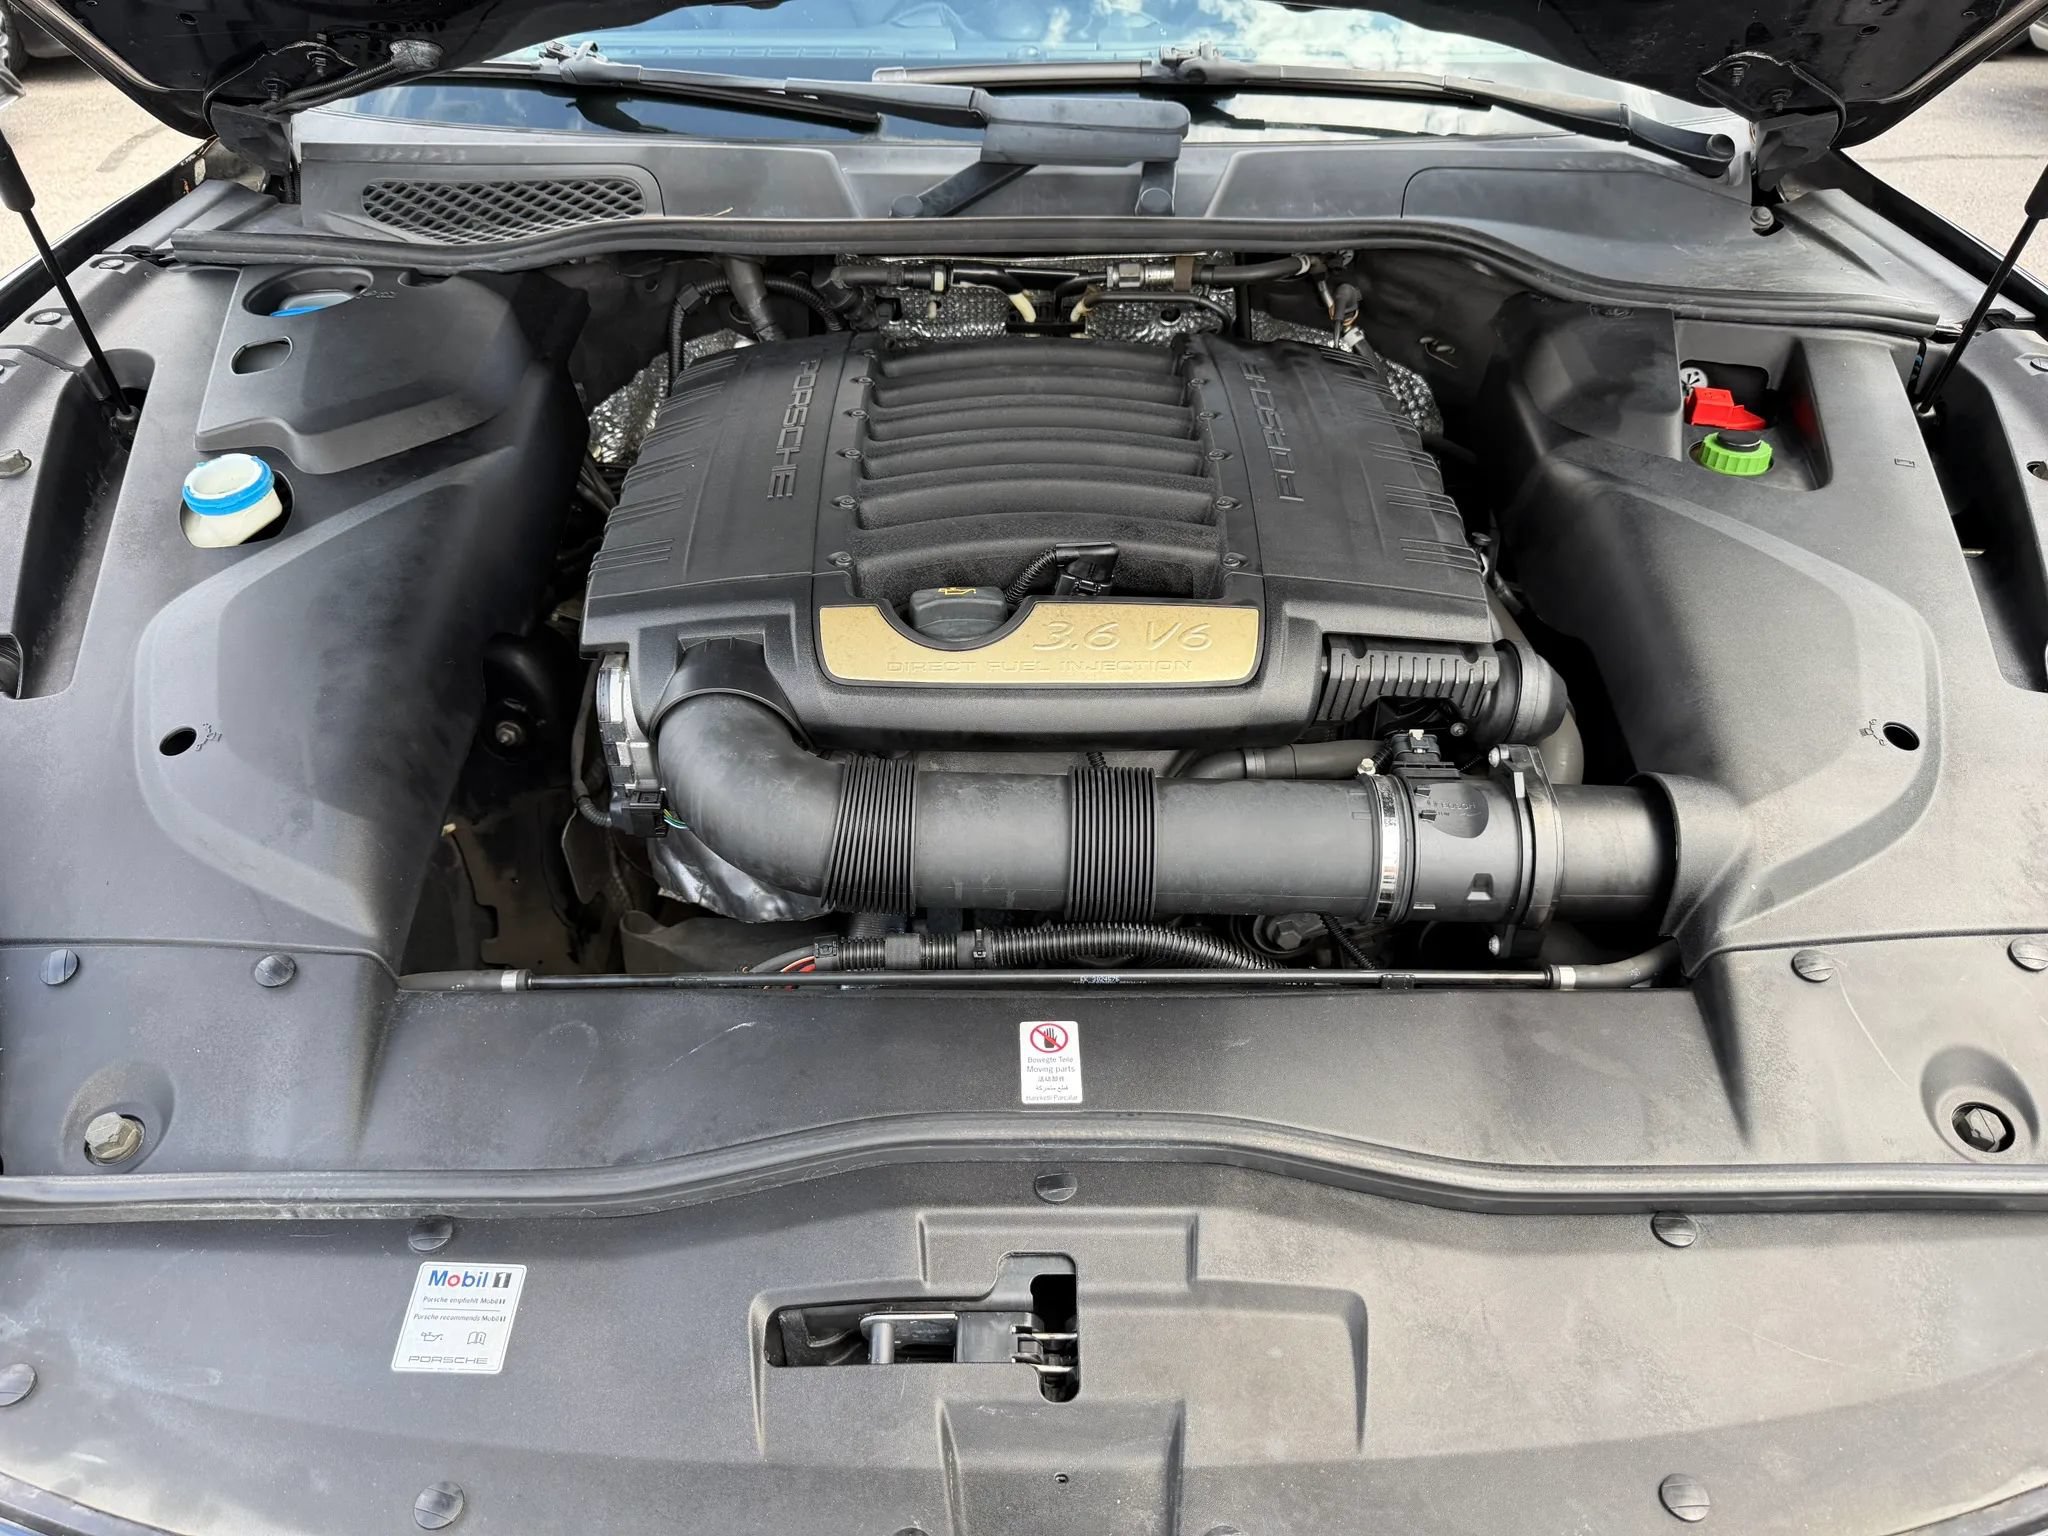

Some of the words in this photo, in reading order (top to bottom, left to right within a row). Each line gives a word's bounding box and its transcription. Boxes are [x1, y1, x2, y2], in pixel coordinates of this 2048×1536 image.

[767, 358, 823, 498] PORSCHE
[1240, 361, 1305, 502] PORSCHE
[1031, 620, 1121, 652] 3.6
[1145, 620, 1214, 652] V6
[885, 660, 976, 673] DIRECT
[986, 660, 1050, 673] FUEL
[1060, 660, 1193, 672] INJECTION
[1026, 1065, 1054, 1074] Moving
[1055, 1065, 1076, 1074] parts
[428, 1270, 489, 1288] Mobil
[413, 1313, 439, 1321] Porsche
[408, 1355, 489, 1365] PORSCHE
